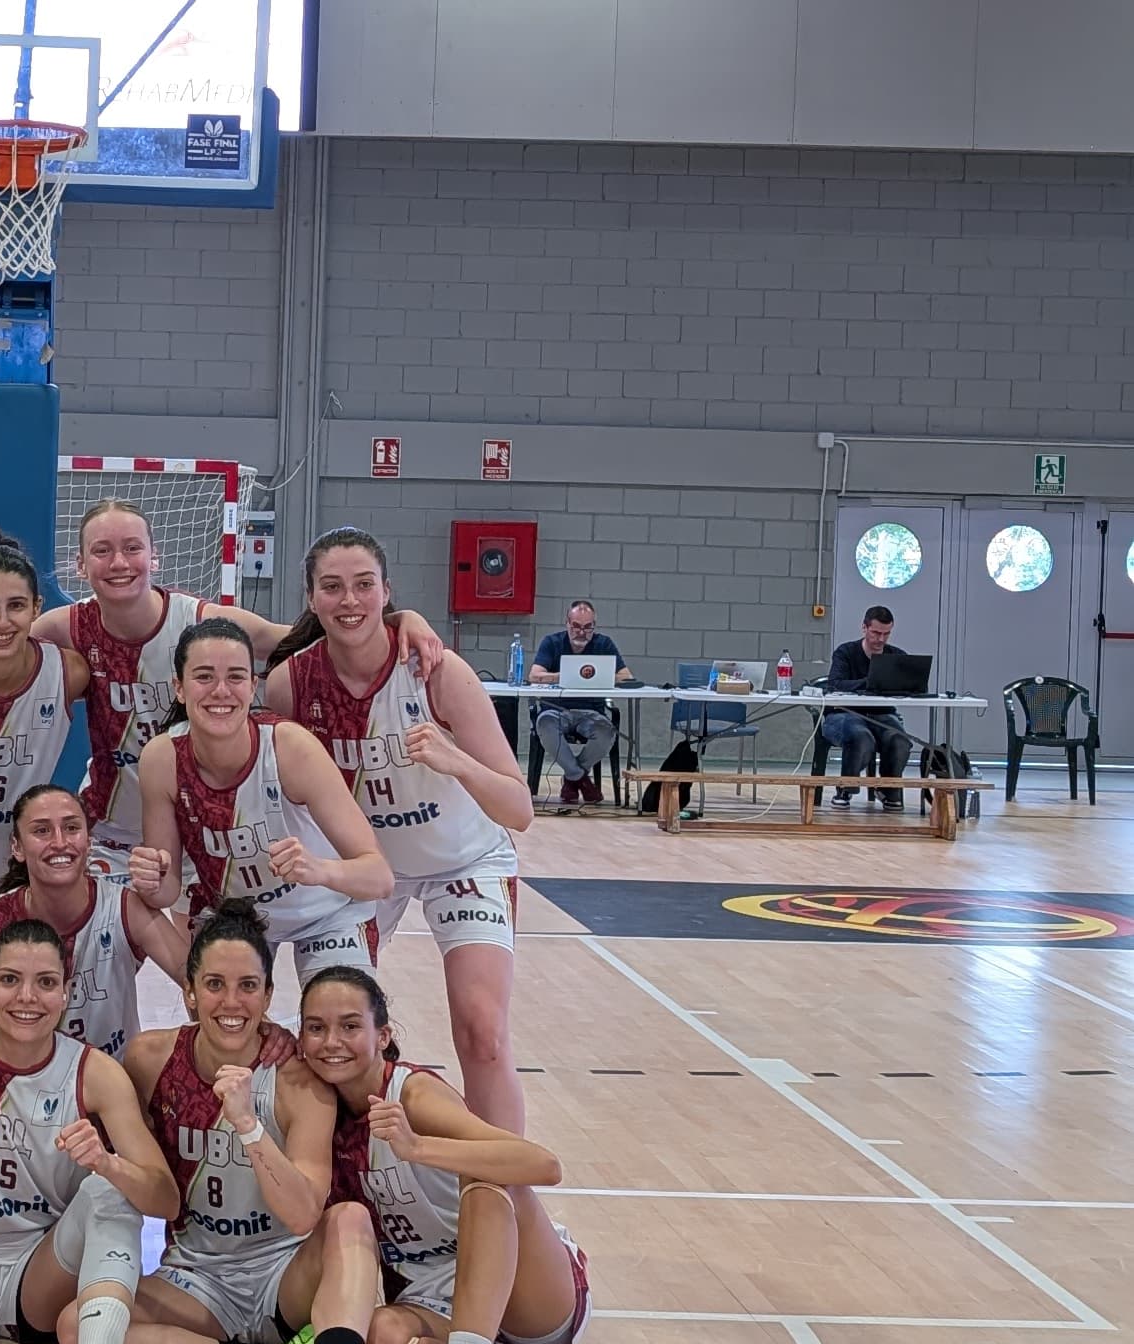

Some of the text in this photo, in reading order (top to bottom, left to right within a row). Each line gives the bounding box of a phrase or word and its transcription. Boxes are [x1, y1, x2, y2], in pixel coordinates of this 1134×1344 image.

[187, 137, 239, 148] FASE FINAL
[332, 733, 414, 772] UBL
[365, 777, 395, 806] 14
[368, 802, 441, 829] sonit
[201, 821, 279, 860] UBL
[238, 864, 263, 889] 11
[457, 909, 507, 926] RIOJA
[312, 937, 359, 953] RIOJA
[65, 967, 108, 1010] BL
[178, 1125, 253, 1169] UBL
[206, 1175, 224, 1208] 8
[189, 1209, 272, 1237] osonit
[382, 1213, 424, 1245] 22
